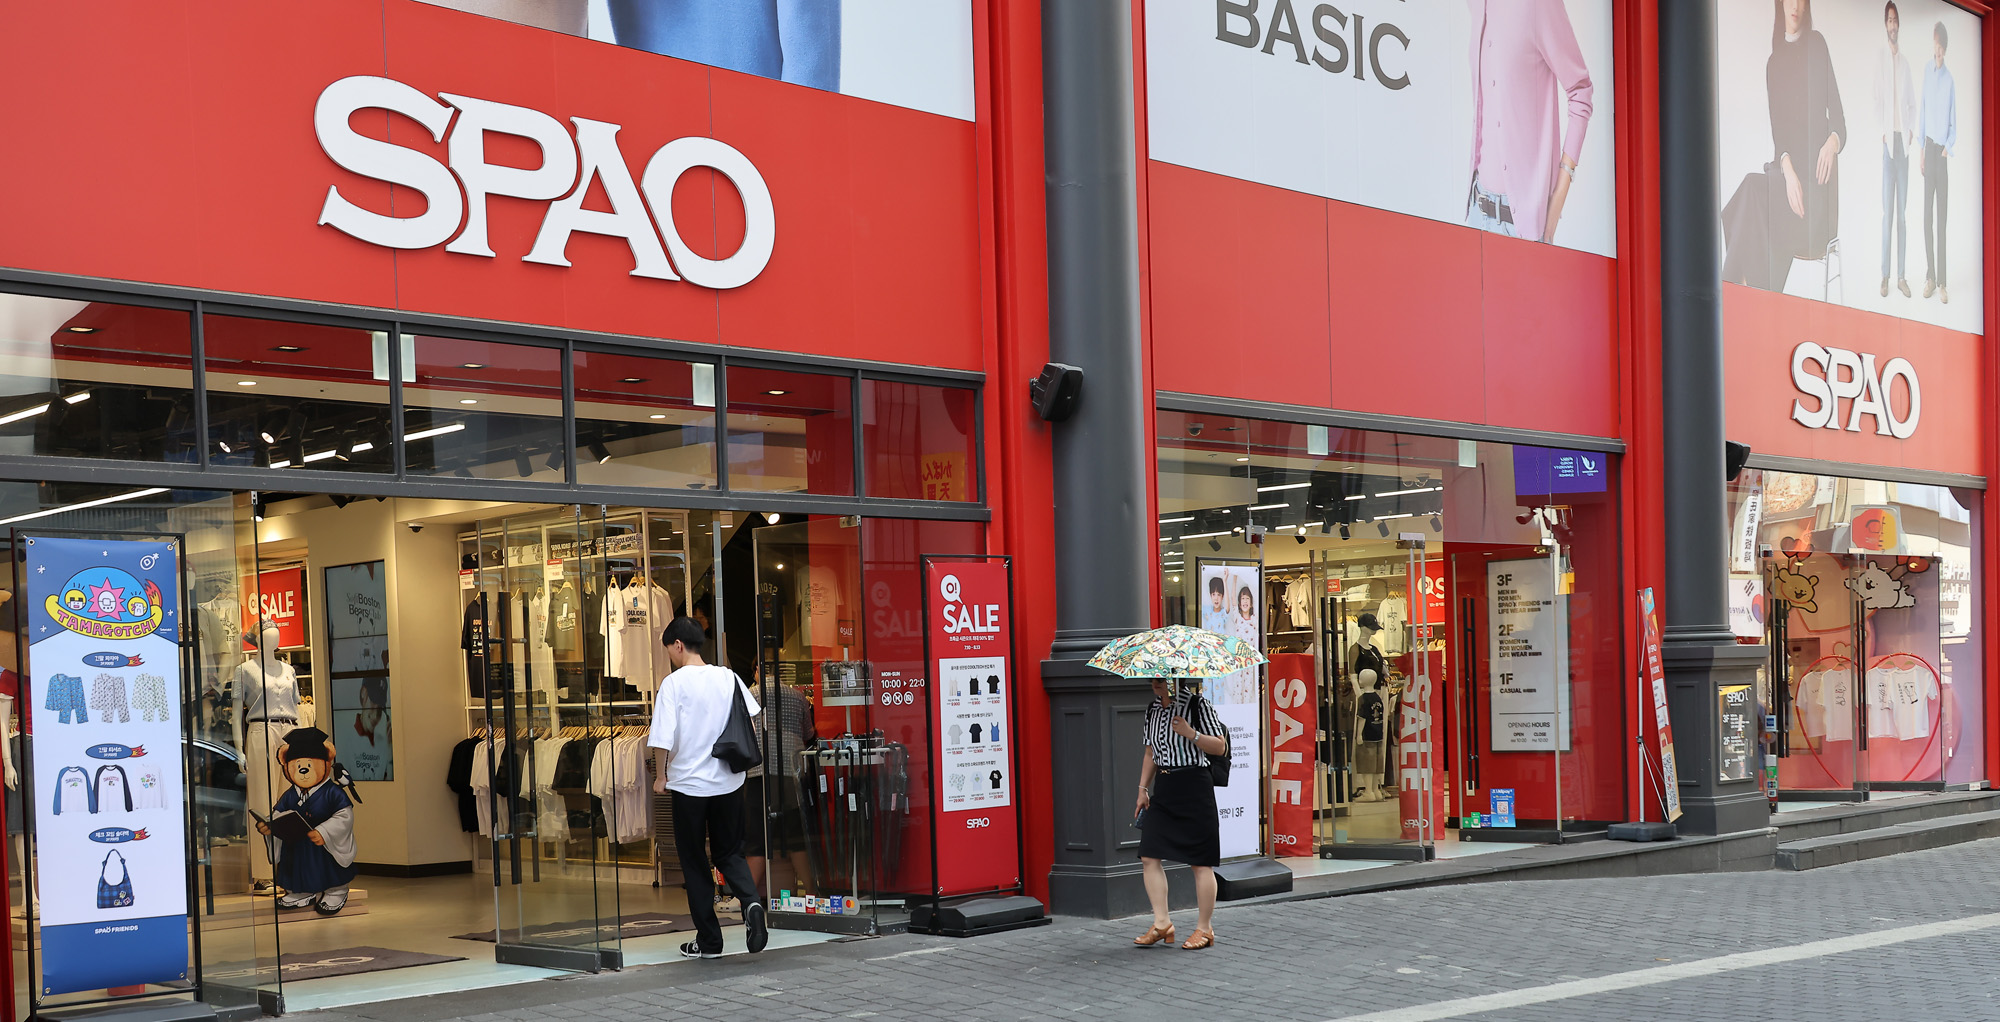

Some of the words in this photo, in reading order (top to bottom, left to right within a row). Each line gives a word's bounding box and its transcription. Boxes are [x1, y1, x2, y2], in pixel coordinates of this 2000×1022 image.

[1216, 0, 1411, 90] BASIC
[313, 75, 776, 290] SPAO
[1791, 341, 1921, 439] SPAO
[1496, 574, 1512, 586] 3F
[260, 590, 295, 620] SALE
[358, 593, 381, 609] Boston
[348, 604, 369, 618] Bears
[57, 610, 156, 637] TAMAGOTCHI
[942, 604, 1000, 634] SALE
[1499, 624, 1513, 636] 2F
[881, 679, 901, 688] 10:00
[909, 678, 925, 688] 22:0
[1500, 673, 1513, 685] 1F
[1726, 692, 1745, 703] SPAO
[1402, 674, 1432, 792] SALE
[1273, 678, 1307, 805] SALE
[362, 752, 380, 760] Boston
[1235, 807, 1244, 817] 3F
[967, 817, 990, 829] SPAO
[1273, 833, 1297, 845] SPAO
